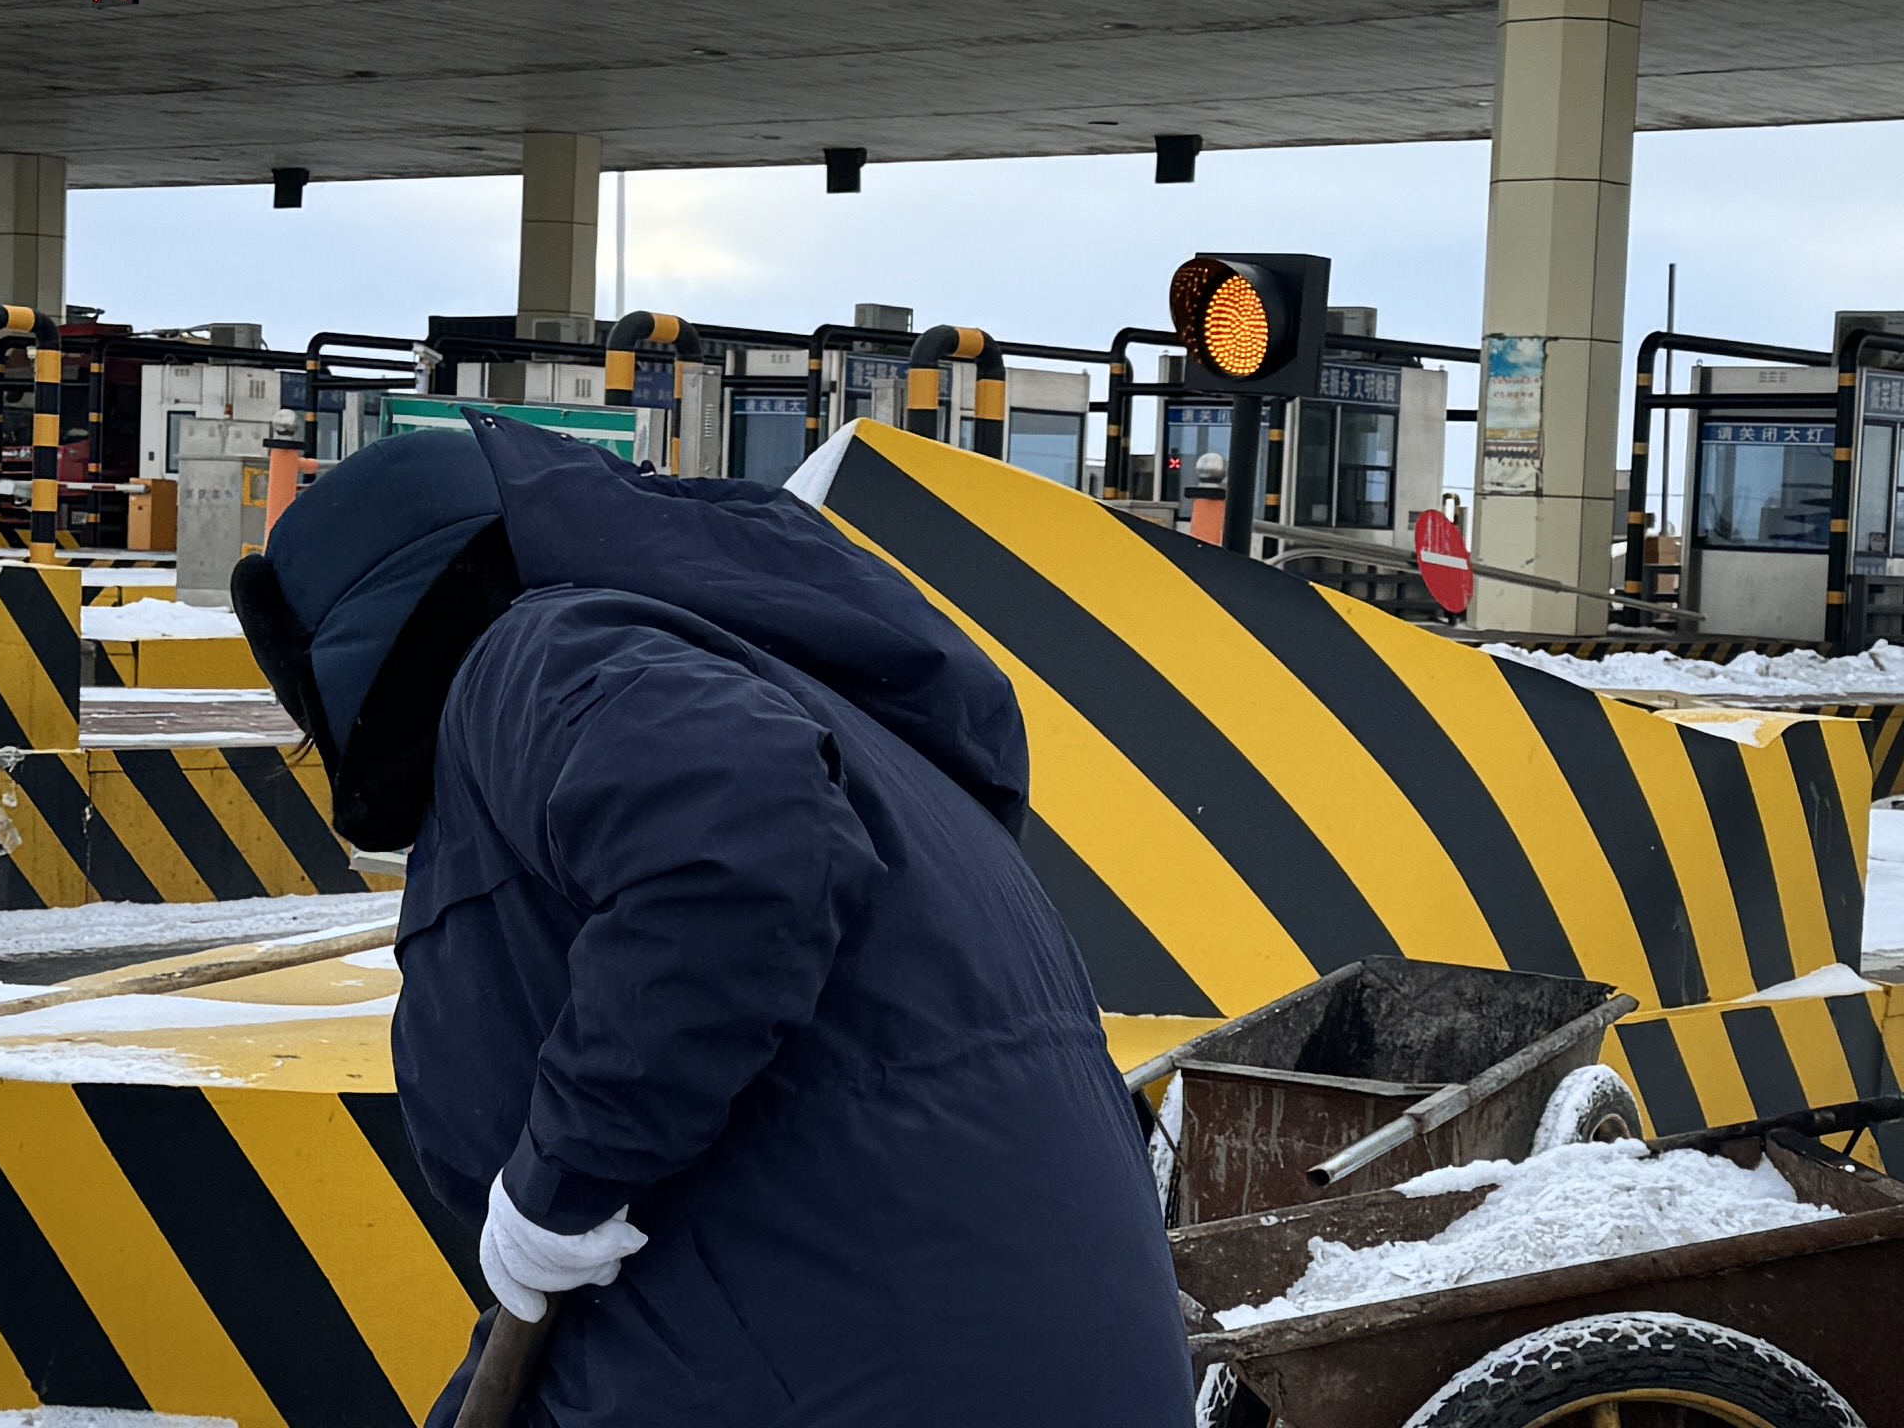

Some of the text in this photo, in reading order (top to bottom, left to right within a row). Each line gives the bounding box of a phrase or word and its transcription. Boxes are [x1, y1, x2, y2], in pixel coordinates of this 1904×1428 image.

[1319, 368, 1350, 398] 笑服务
[744, 399, 802, 412] 请关闭大
[1717, 426, 1825, 443] 请关闭大灯
